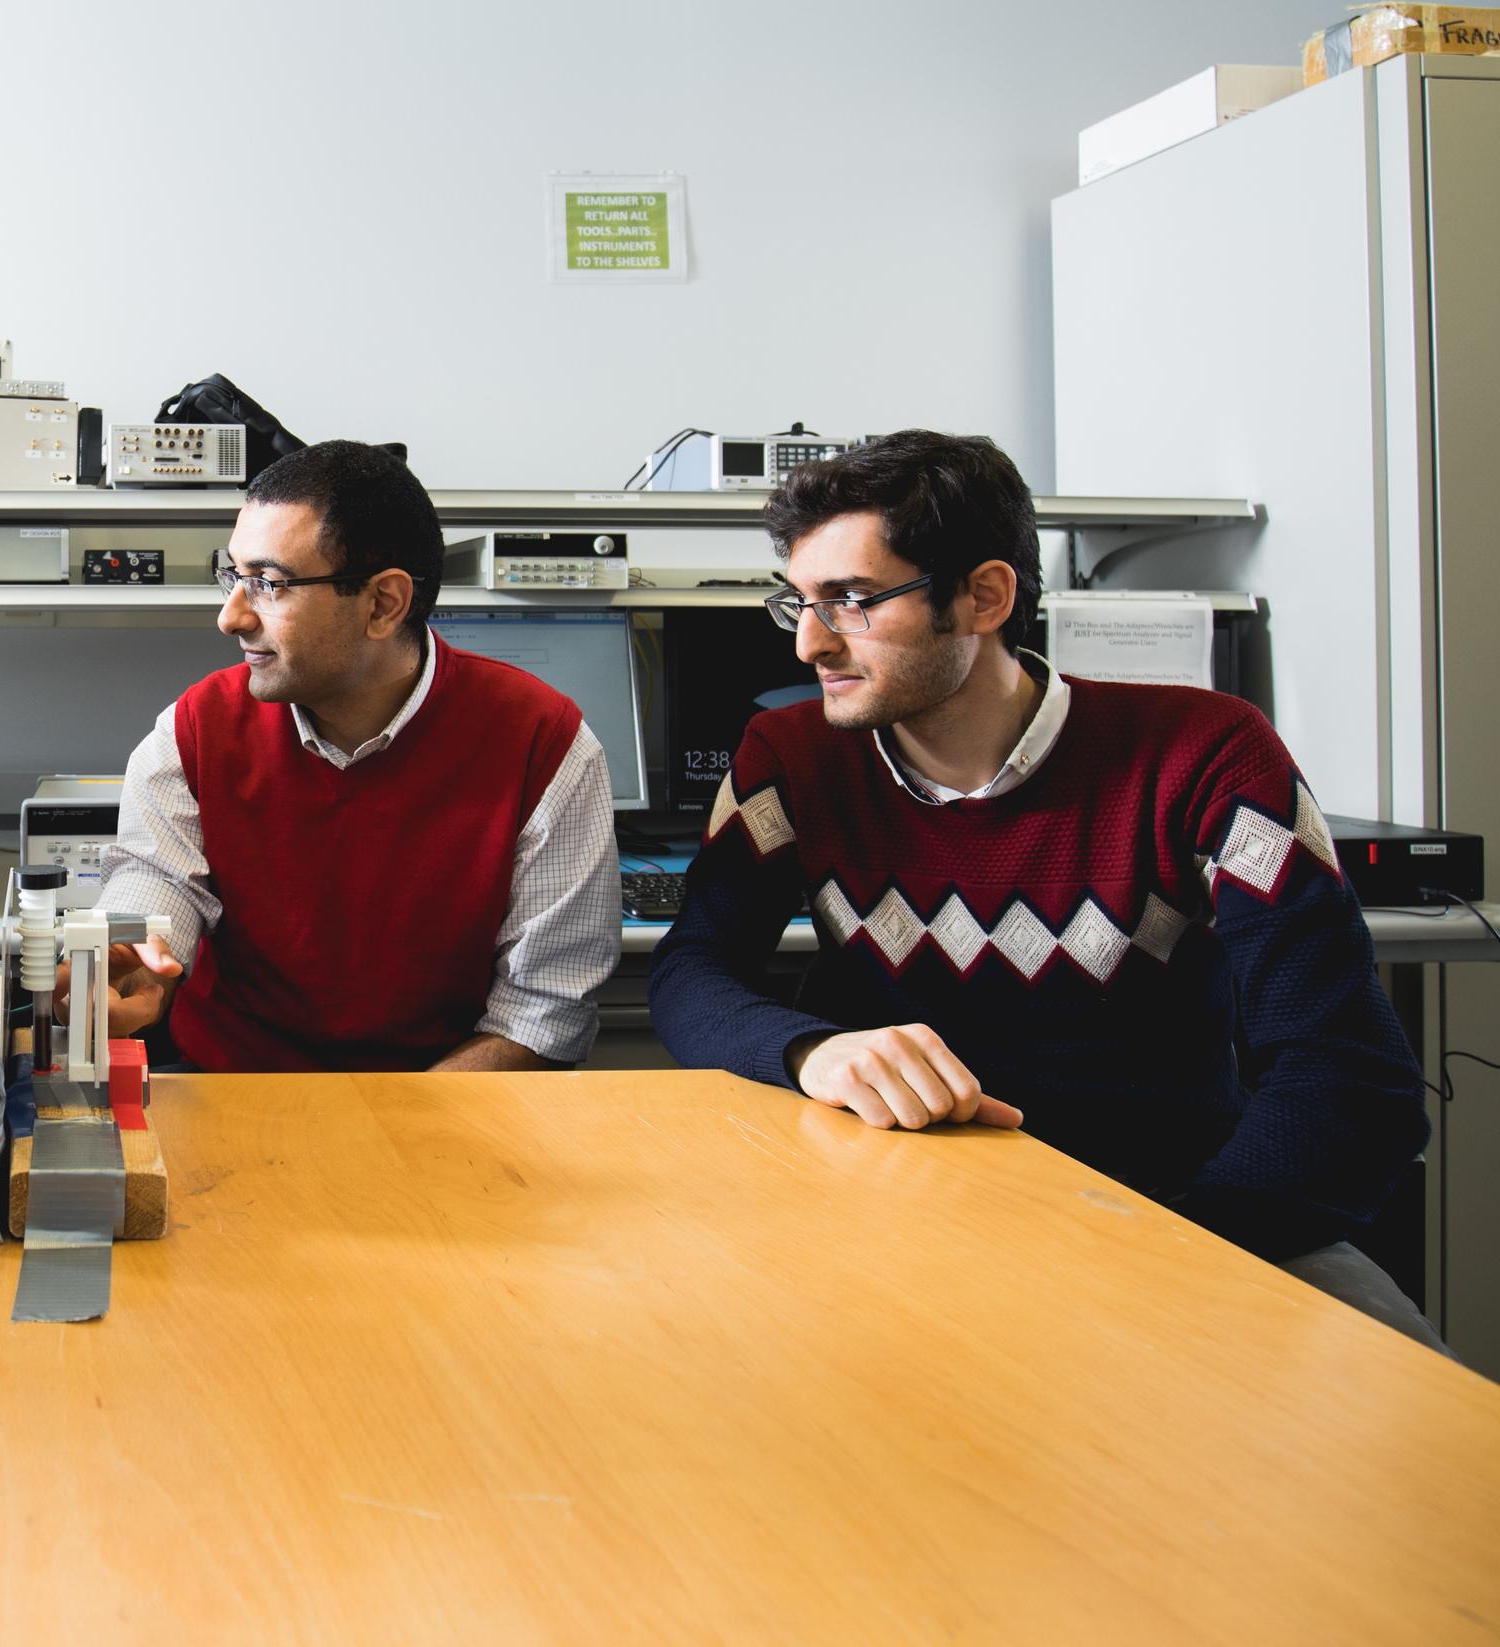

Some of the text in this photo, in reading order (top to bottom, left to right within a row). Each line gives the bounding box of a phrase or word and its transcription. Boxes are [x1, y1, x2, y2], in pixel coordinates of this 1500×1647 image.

[1438, 20, 1500, 46] FRAG
[577, 196, 656, 206] REMEMBER TO
[584, 211, 649, 221] RETURN ALL
[579, 241, 656, 252] INSTRUMENTS
[576, 256, 661, 267] TO THE SHELVES
[1074, 629, 1091, 638] JUST
[684, 751, 729, 768] 12:38
